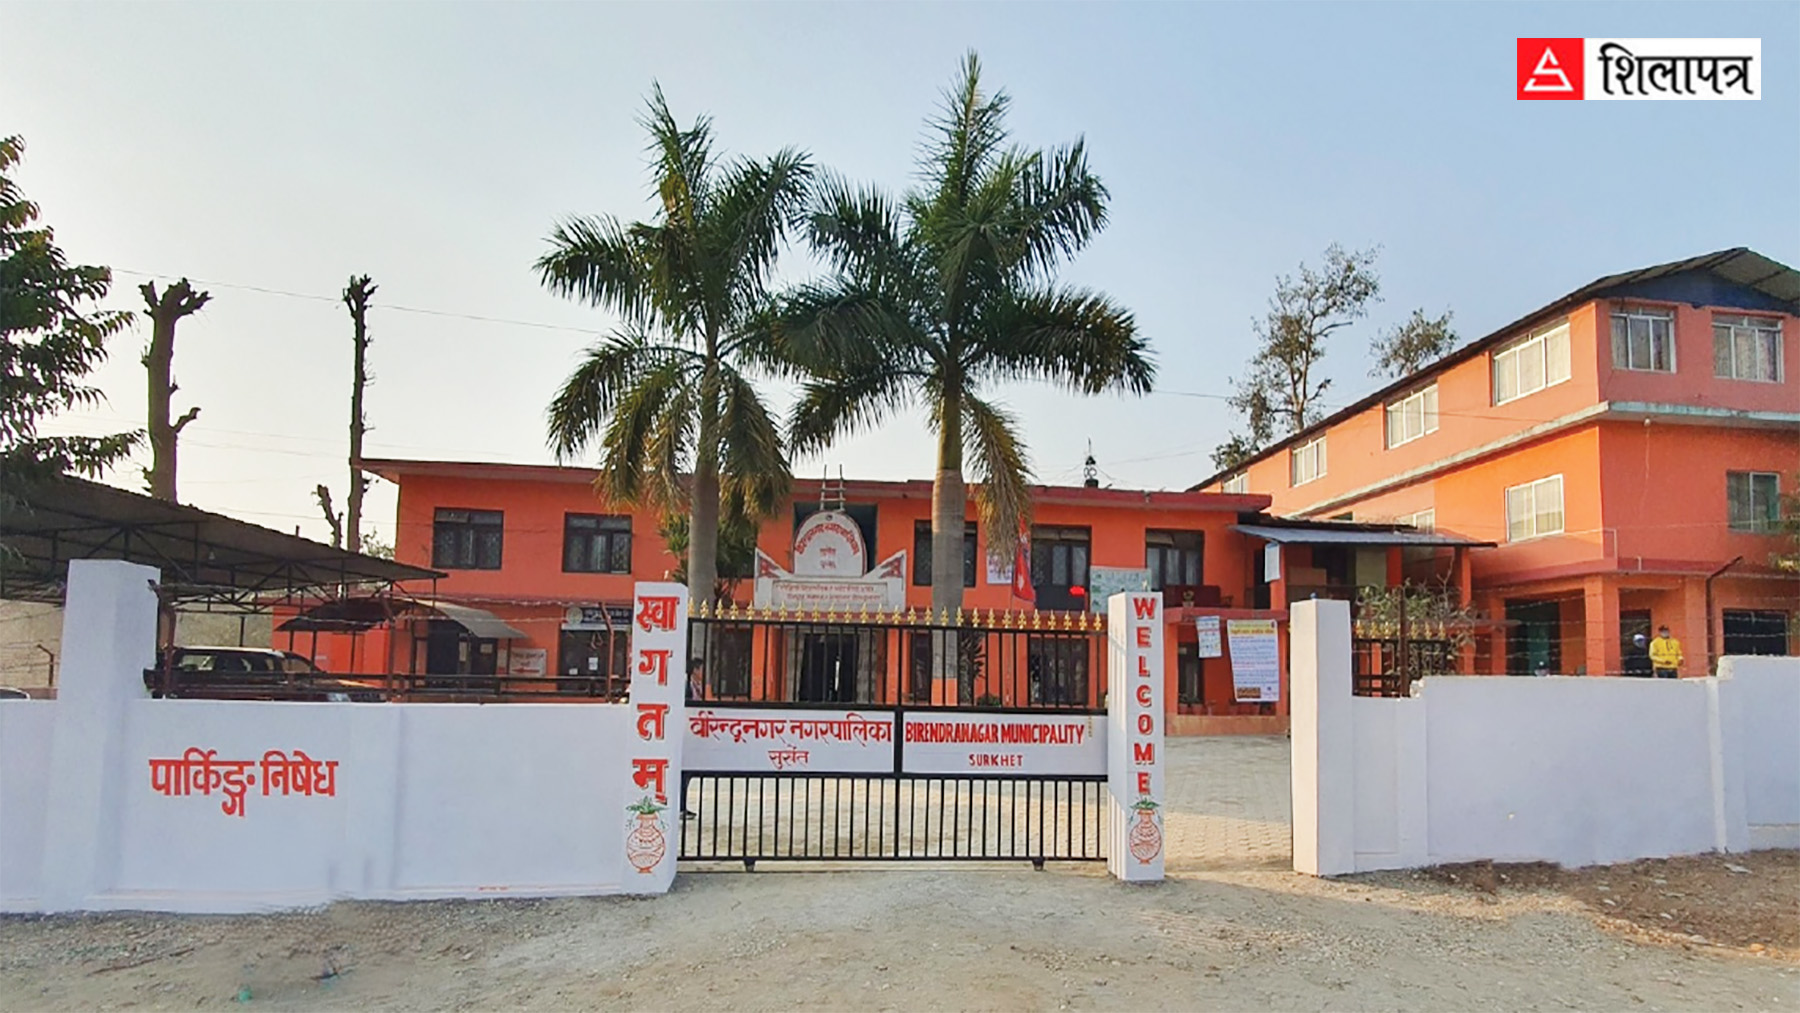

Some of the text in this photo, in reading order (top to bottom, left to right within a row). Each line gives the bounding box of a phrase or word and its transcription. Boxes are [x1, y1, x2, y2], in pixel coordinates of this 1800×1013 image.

[1133, 597, 1157, 795] WELCOME
[790, 713, 892, 747] नगरपालिका
[905, 721, 1085, 745] BIRENDRANAGAR MUNICIPALITY
[259, 750, 339, 797] निषेध
[969, 753, 1024, 767] SURKHET
